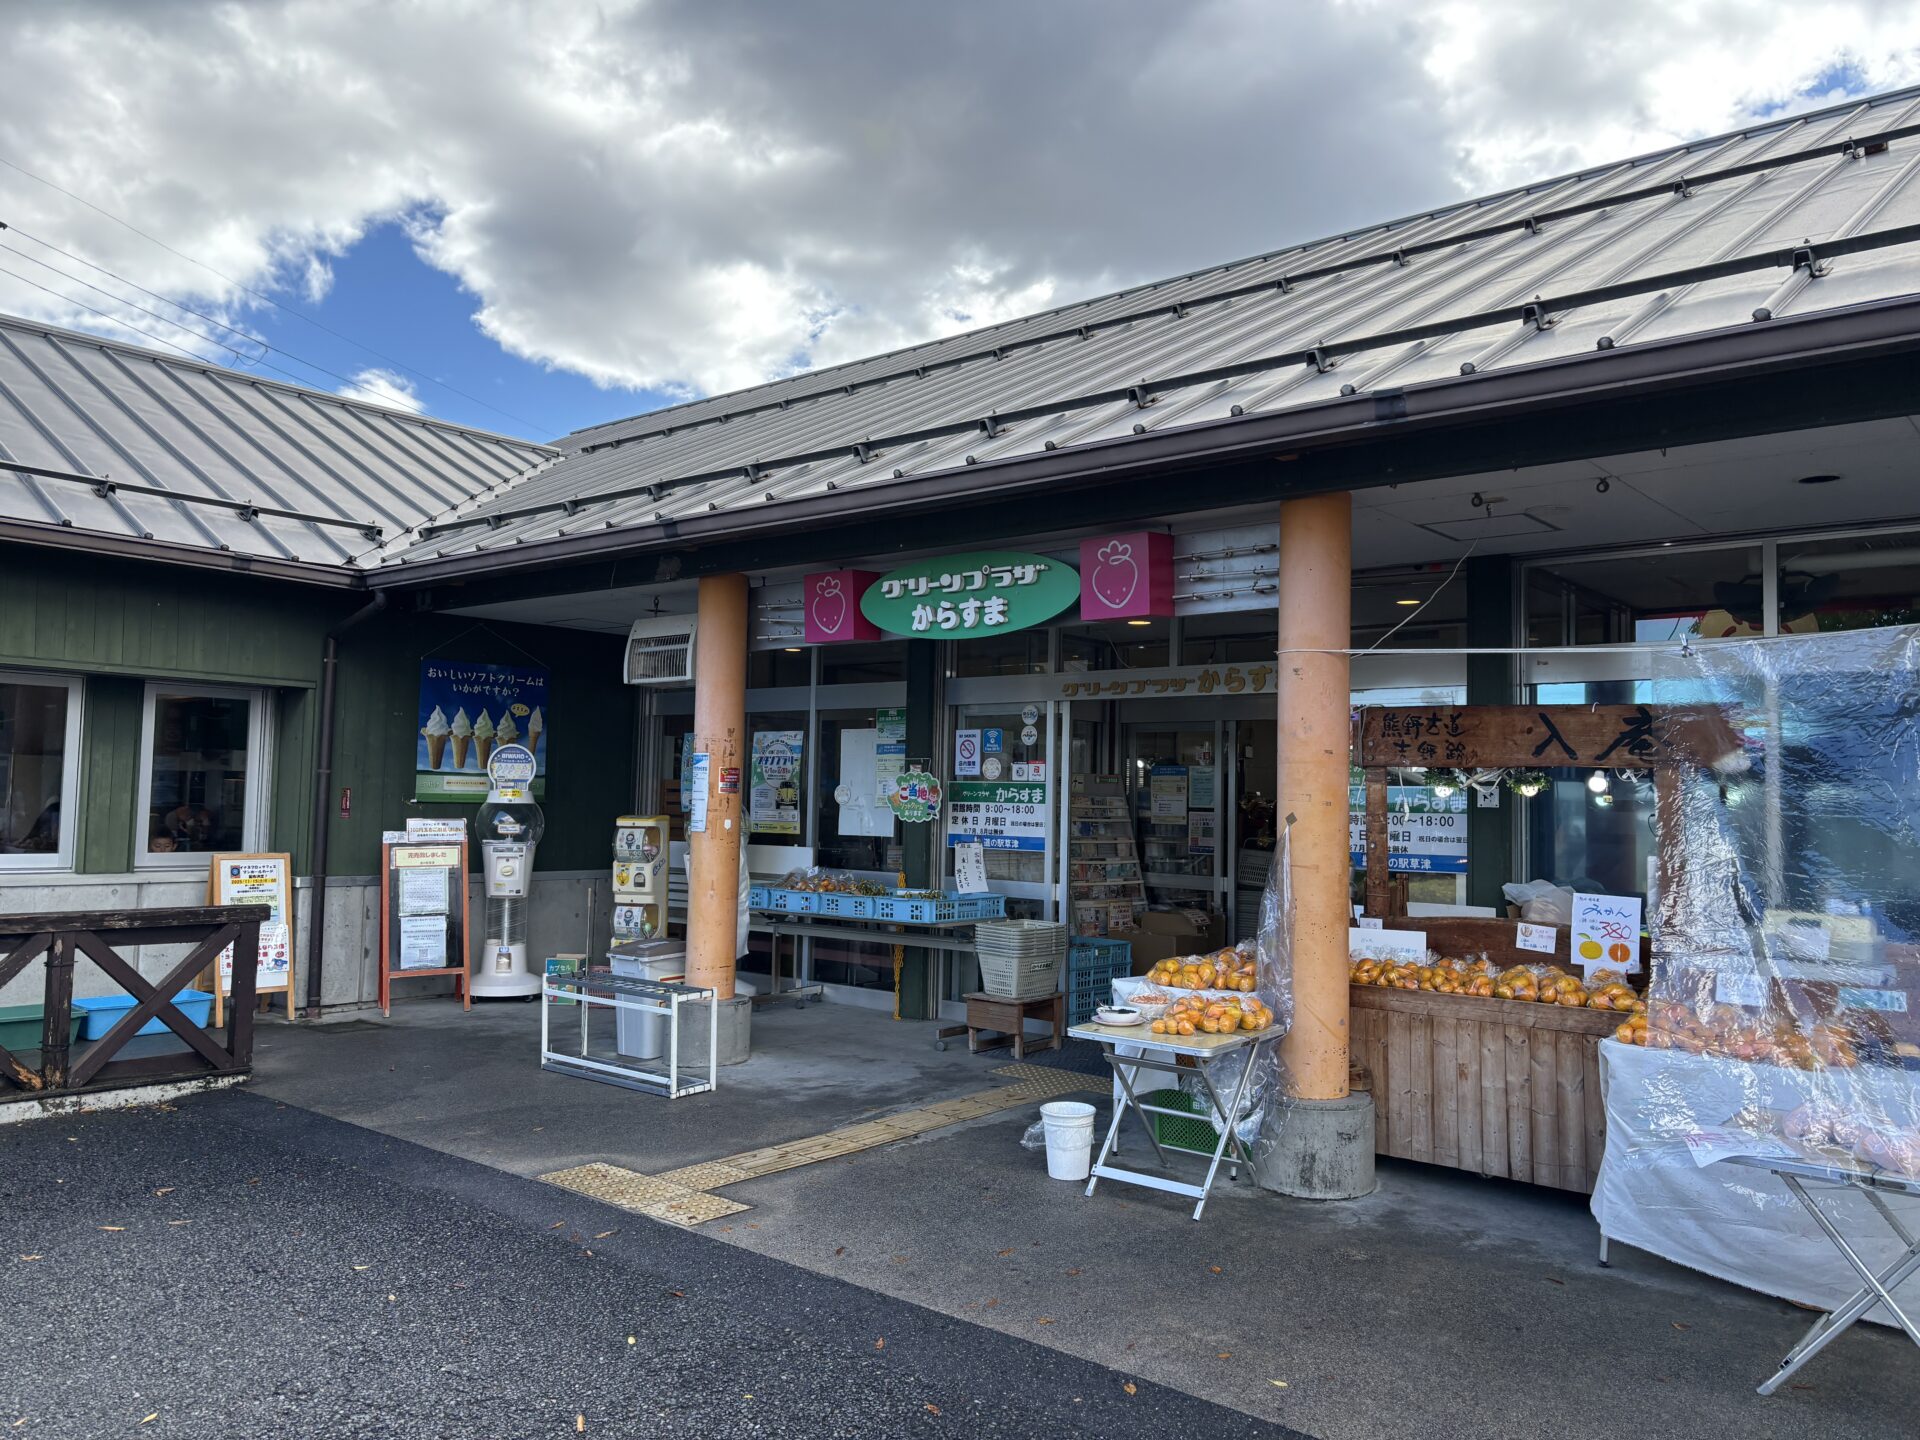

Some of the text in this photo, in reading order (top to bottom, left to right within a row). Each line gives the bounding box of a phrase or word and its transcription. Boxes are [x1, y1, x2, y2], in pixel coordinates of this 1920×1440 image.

[881, 564, 1049, 598] グリーンプラザ
[911, 595, 1009, 631] からすま
[427, 667, 544, 687] おいしいソフトクリームは
[1061, 665, 1278, 697] グリーンプラザ からす
[452, 684, 520, 697] いかがですか?
[1381, 712, 1466, 740] 熊野古道
[900, 782, 928, 802] ご当地
[996, 787, 1043, 803] からすま
[984, 817, 1007, 827] 月曜日
[983, 838, 1019, 848] 道の駅草津
[1388, 857, 1432, 870] の駅草津
[1582, 903, 1632, 918] みかん
[1599, 921, 1632, 939] 380
